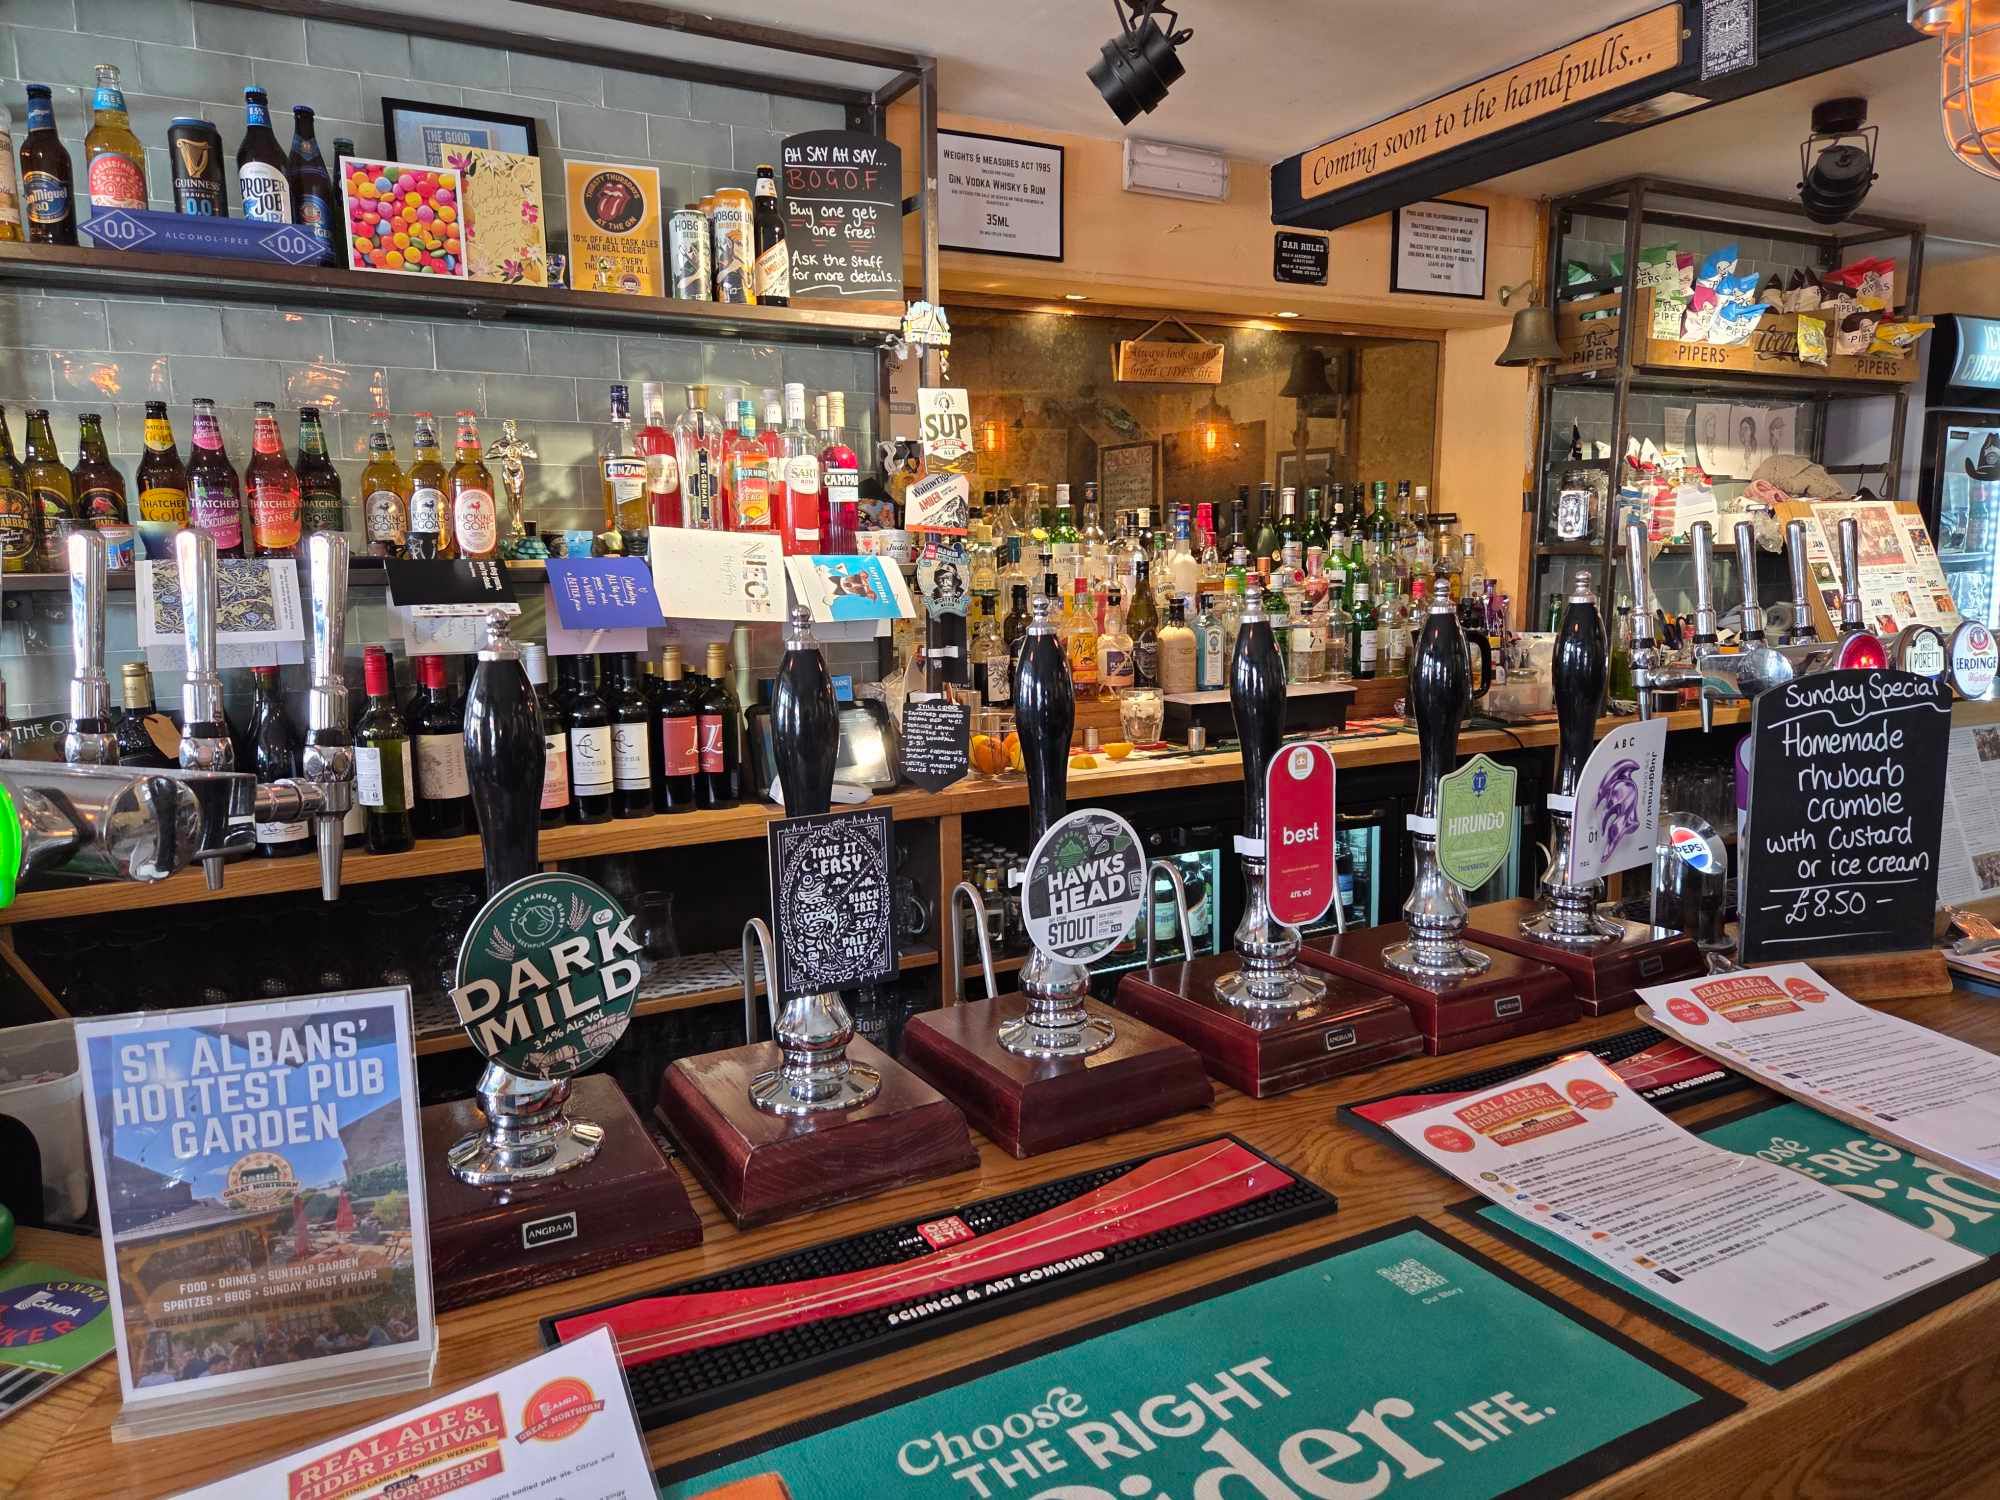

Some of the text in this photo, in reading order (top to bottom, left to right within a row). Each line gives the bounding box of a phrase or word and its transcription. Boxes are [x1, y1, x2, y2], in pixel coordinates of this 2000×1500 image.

[1313, 33, 1652, 185] Coming soon to the handpulls...
[425, 129, 471, 144] THE GOOD
[785, 147, 801, 162] AH
[807, 147, 828, 162] SAY
[833, 148, 849, 162] AH
[943, 149, 1051, 172] WEIGHTS & MEASURES ACT 1985
[175, 178, 221, 191] GUINNESS
[240, 177, 286, 198] PROPER
[966, 175, 991, 188] VODKA
[993, 179, 1020, 192] WHISKY
[1030, 184, 1046, 195] RUM
[186, 199, 212, 215] 0.0
[255, 192, 283, 215] JOB
[789, 202, 877, 228] Buy one get
[608, 221, 625, 231] THE
[813, 224, 876, 239] one free!
[986, 214, 1009, 227] 35ML
[104, 219, 307, 254] 0.0 ALCOHOL-FREE 0.0
[573, 234, 658, 248] 10% OFF ALL CASK ALES
[586, 242, 645, 254] AND REAL CIDERS
[1282, 240, 1325, 252] BAR RULES
[792, 250, 847, 266] Ask the
[792, 267, 845, 281] for more
[1679, 346, 1725, 362] PIPERS
[1858, 360, 1897, 376] PIPERS
[925, 414, 968, 440] SUP
[190, 500, 240, 509] THATCHERS
[919, 491, 943, 512] AMBER
[463, 522, 490, 530] GOAT
[1914, 652, 1941, 668] PORETTI
[1786, 673, 1939, 716] Sunday Special
[13, 723, 44, 740] THE
[1782, 719, 1904, 757] Homemade
[1646, 752, 1658, 816] Juggernaut
[1798, 757, 1904, 791] rhubarb
[1283, 822, 1319, 845] best
[1448, 811, 1505, 837] HIRUNDO
[1588, 831, 1598, 843] 01
[1767, 830, 1816, 853] with
[811, 842, 857, 859] TAKE IT
[820, 855, 863, 875] EASY
[1048, 854, 1125, 894] HAWKS
[1798, 852, 1928, 878] or ice cream
[849, 889, 879, 904] BLACK
[1050, 874, 1125, 916] HEAD
[1785, 887, 1866, 925] £8.50
[523, 893, 558, 904] HANDED
[556, 902, 567, 929] GIANT
[854, 901, 878, 913] IRIS
[854, 917, 877, 930] 3.4%
[1048, 916, 1095, 946] STOUT
[842, 934, 868, 948] PALE
[846, 945, 865, 958] ALE
[453, 914, 643, 1026] DARK
[1697, 977, 1757, 998] REAL ALE
[1705, 986, 1781, 1007] CIDER FESTIVAL
[477, 959, 642, 1057] MILD
[534, 1009, 603, 1049] 3.4% Alc Vol
[120, 1019, 368, 1084] ST ALBANS'
[112, 1058, 384, 1126] HOTTEST PUB
[1460, 1088, 1533, 1121] REAL ALE
[1471, 1096, 1562, 1129] CIDER FESTIVAL
[171, 1102, 339, 1159] GARDEN
[529, 1222, 572, 1239] ANGRAM
[180, 1258, 359, 1294] FOOD DRINKS SUNTRAP GARDEN
[47, 1282, 108, 1303] LONDON
[163, 1269, 377, 1313] SPRITZES BBQS SUNDAY ROAST WRAPS
[888, 1251, 1105, 1325] SCIENCE & ART COMBINED
[33, 1299, 82, 1317] CAMRA
[519, 1402, 602, 1441] GREAT NORTHERN
[897, 1385, 1089, 1478] Choose
[950, 1356, 1292, 1497] THE RIGHT
[1433, 1391, 1557, 1451] LIFE.
[301, 1406, 485, 1487] REAL ALE &
[295, 1419, 499, 1500] CIDER FESTIVAL
[367, 1441, 489, 1491] CAMRA WEEKEND
[540, 1476, 557, 1486] pale
[601, 1452, 615, 1462] and
[378, 1458, 489, 1500] NORTHERN
